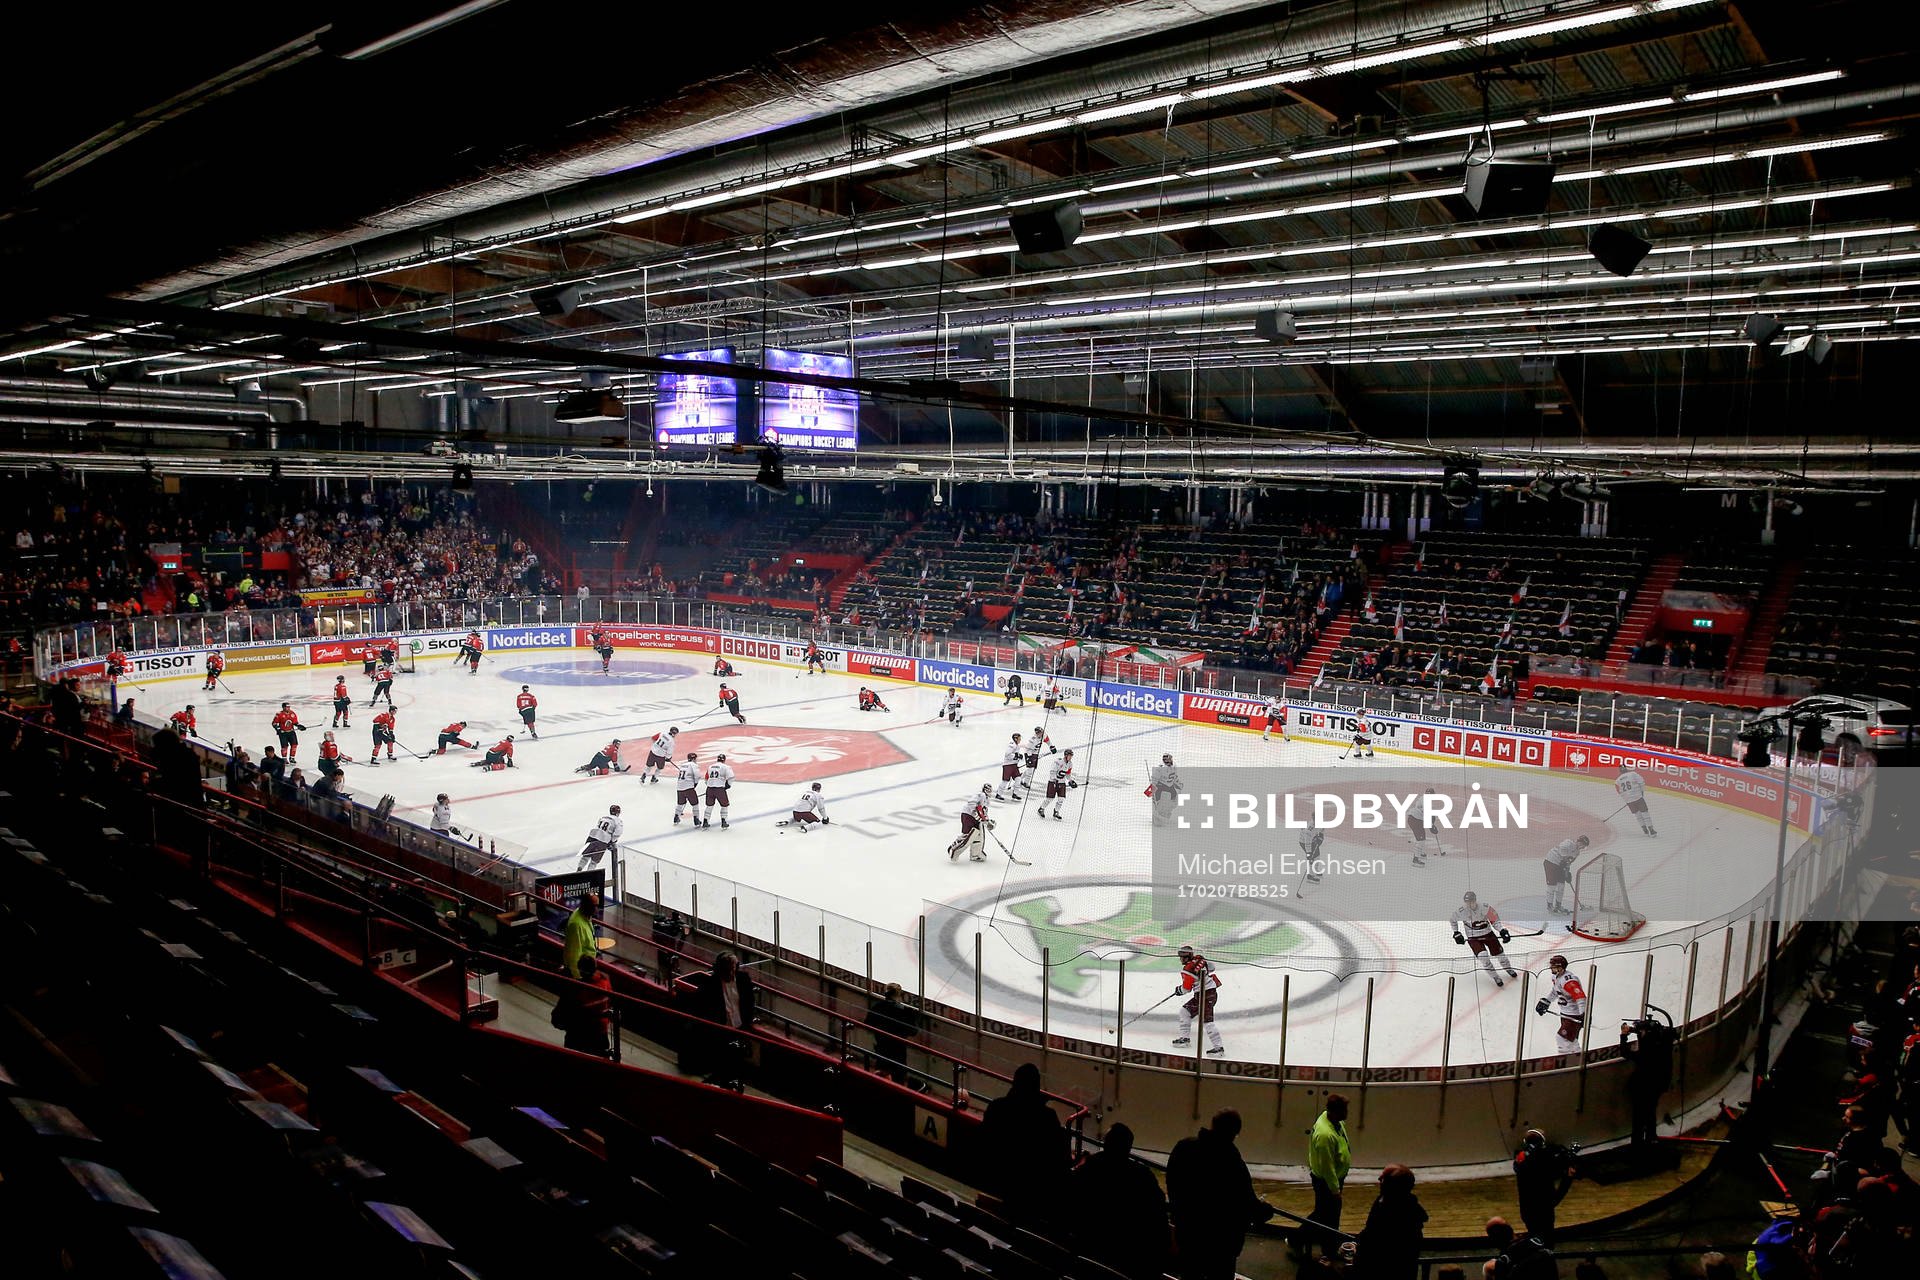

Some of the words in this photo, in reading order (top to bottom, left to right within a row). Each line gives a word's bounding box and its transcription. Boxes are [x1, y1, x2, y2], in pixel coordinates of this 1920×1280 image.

[670, 434, 695, 444] CHAMPIONS
[696, 433, 716, 444] HOCKEY
[716, 432, 735, 444] LEAGUE
[778, 434, 812, 446] CHAMPIONS
[814, 435, 836, 448] HOCKEY
[836, 437, 856, 449] LEAGUE
[428, 638, 466, 650] ŠKOD
[493, 632, 566, 648] NordicBet
[664, 633, 703, 643] strauss
[725, 640, 778, 658] CRAMO
[134, 655, 194, 672] TISSOT
[226, 654, 290, 664] WWW.ENGELBERG.CH
[922, 664, 990, 689] NordicBet
[1209, 690, 1233, 698] TISSOT
[1090, 687, 1172, 714] NordicBet
[1288, 699, 1314, 708] TISSOT
[1330, 704, 1356, 713] TISSOT
[1372, 710, 1401, 718] TISSOT
[1418, 714, 1448, 724] TISSOT
[1464, 720, 1496, 730] TISSOT
[1326, 716, 1400, 738] TISOT
[1514, 726, 1547, 736] TISSOT
[1298, 728, 1321, 736] SWISS
[1323, 731, 1353, 741] WATCHE
[1418, 732, 1538, 760] CRAMO
[1598, 752, 1699, 780] engelbert
[1705, 772, 1777, 802] strauss
[1620, 780, 1632, 791] 26
[1659, 778, 1724, 799] workwear
[563, 882, 591, 892] CHAMPIONS
[564, 890, 582, 898] HOCKEY
[923, 1116, 938, 1140] A
